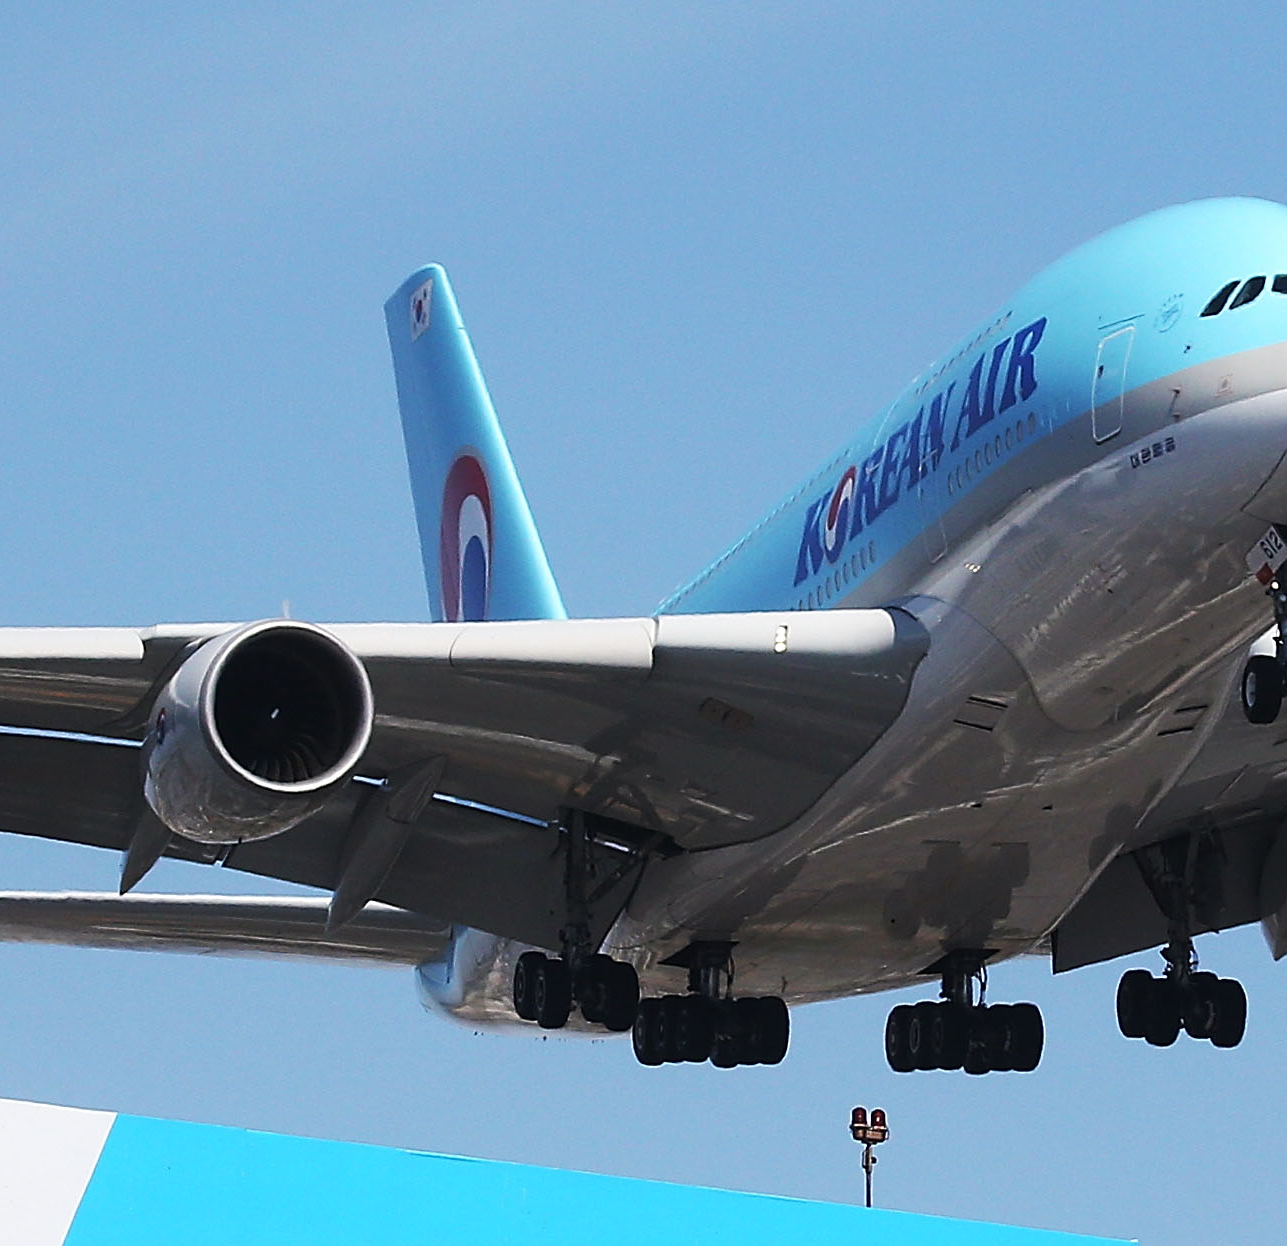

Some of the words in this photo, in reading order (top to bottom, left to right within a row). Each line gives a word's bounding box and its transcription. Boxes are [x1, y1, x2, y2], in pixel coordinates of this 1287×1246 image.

[793, 380, 957, 587] KOREAN
[949, 316, 1048, 453] AIR
[1259, 530, 1284, 560] 612
